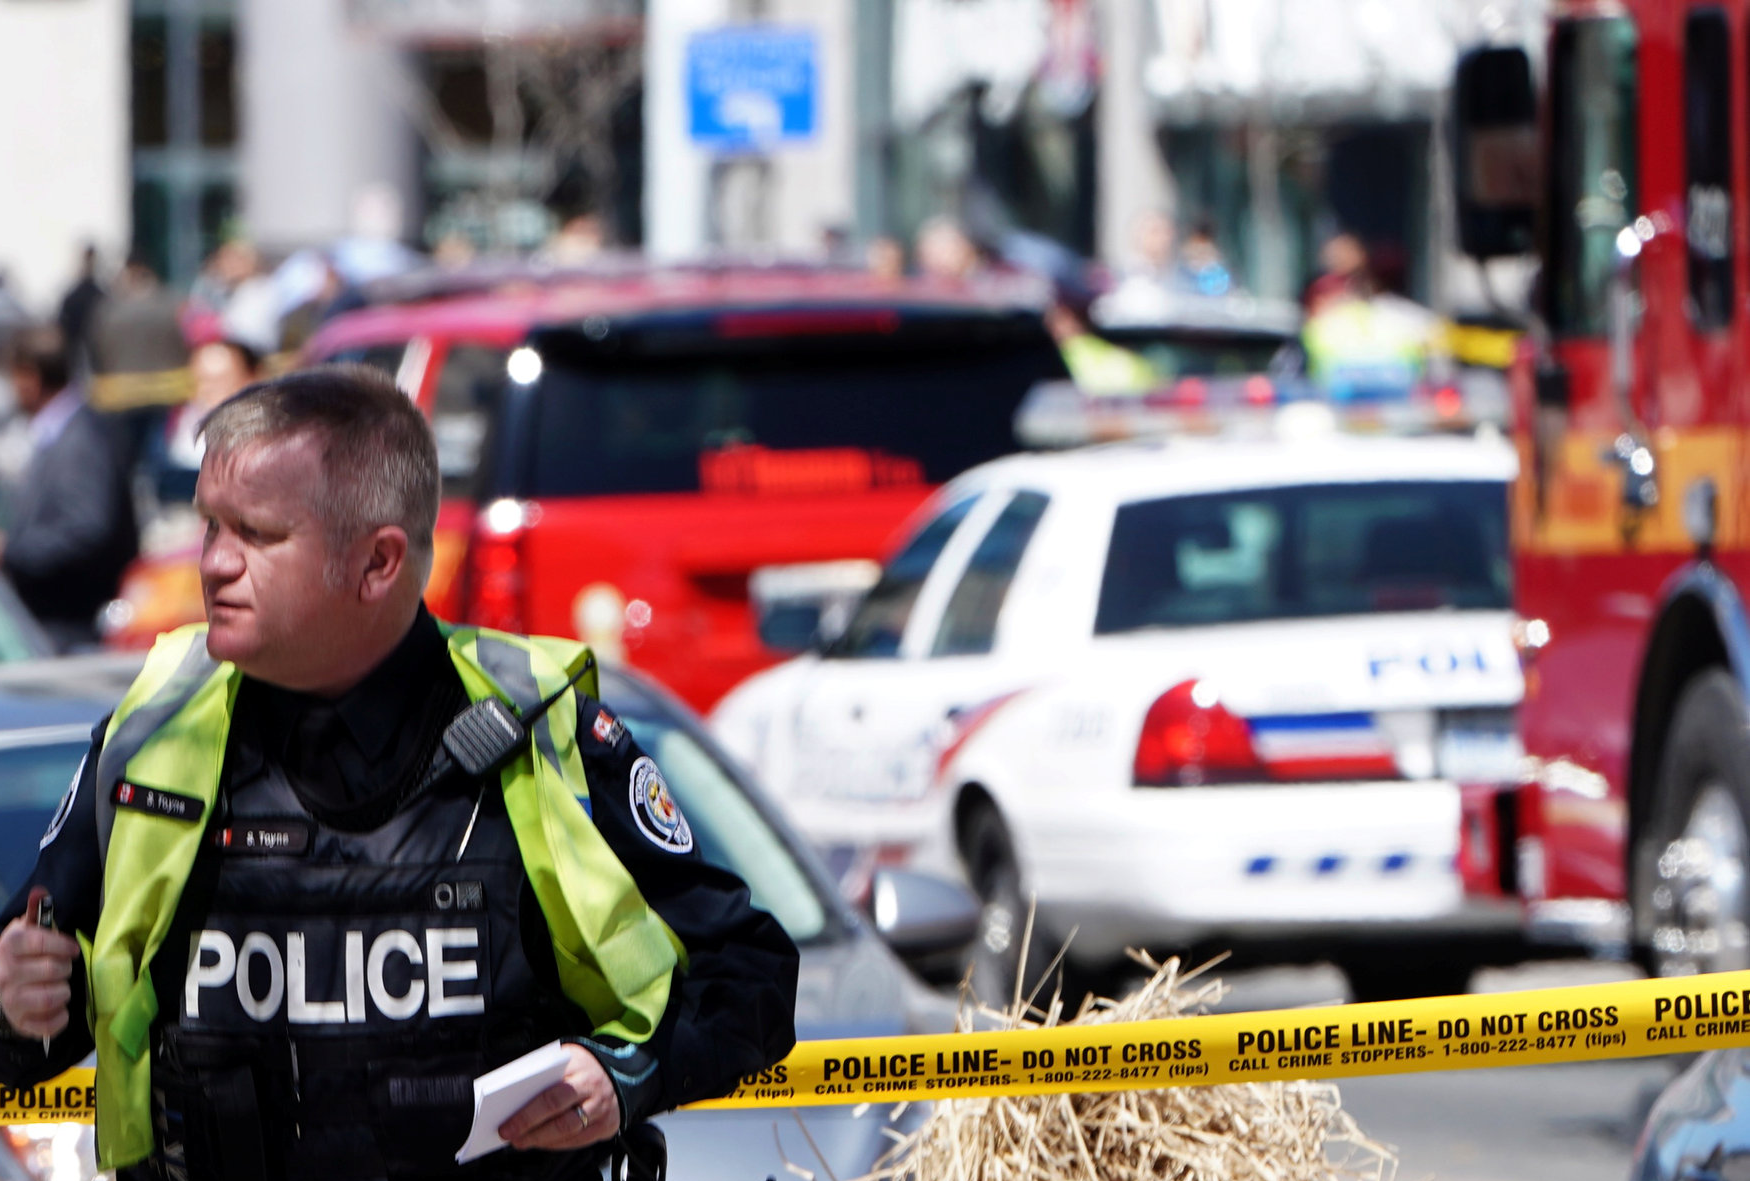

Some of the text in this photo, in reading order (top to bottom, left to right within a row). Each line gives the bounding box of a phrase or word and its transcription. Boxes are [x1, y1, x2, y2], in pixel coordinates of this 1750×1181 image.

[185, 928, 485, 1023] POLICE
[1238, 1025, 1340, 1055] POLICE
[1438, 1018, 1470, 1039] DO
[1481, 1013, 1527, 1036] NOT
[1538, 1006, 1619, 1032] CROSS
[1646, 1019, 1750, 1041] CALL CRIME
[824, 1054, 925, 1080] POLICE
[1023, 1050, 1054, 1069] DO
[1066, 1046, 1112, 1067] NOT
[1122, 1039, 1201, 1063] CROSS
[1229, 1057, 1269, 1071] CALL
[1278, 1053, 1332, 1068] CRIME
[1443, 1034, 1576, 1056] 1-800-222-8477
[1585, 1030, 1626, 1048] (tips)
[0, 1086, 96, 1109] POLICE
[755, 1087, 794, 1100] (tips)
[815, 1083, 854, 1095] CALL
[863, 1080, 917, 1092] CRIME
